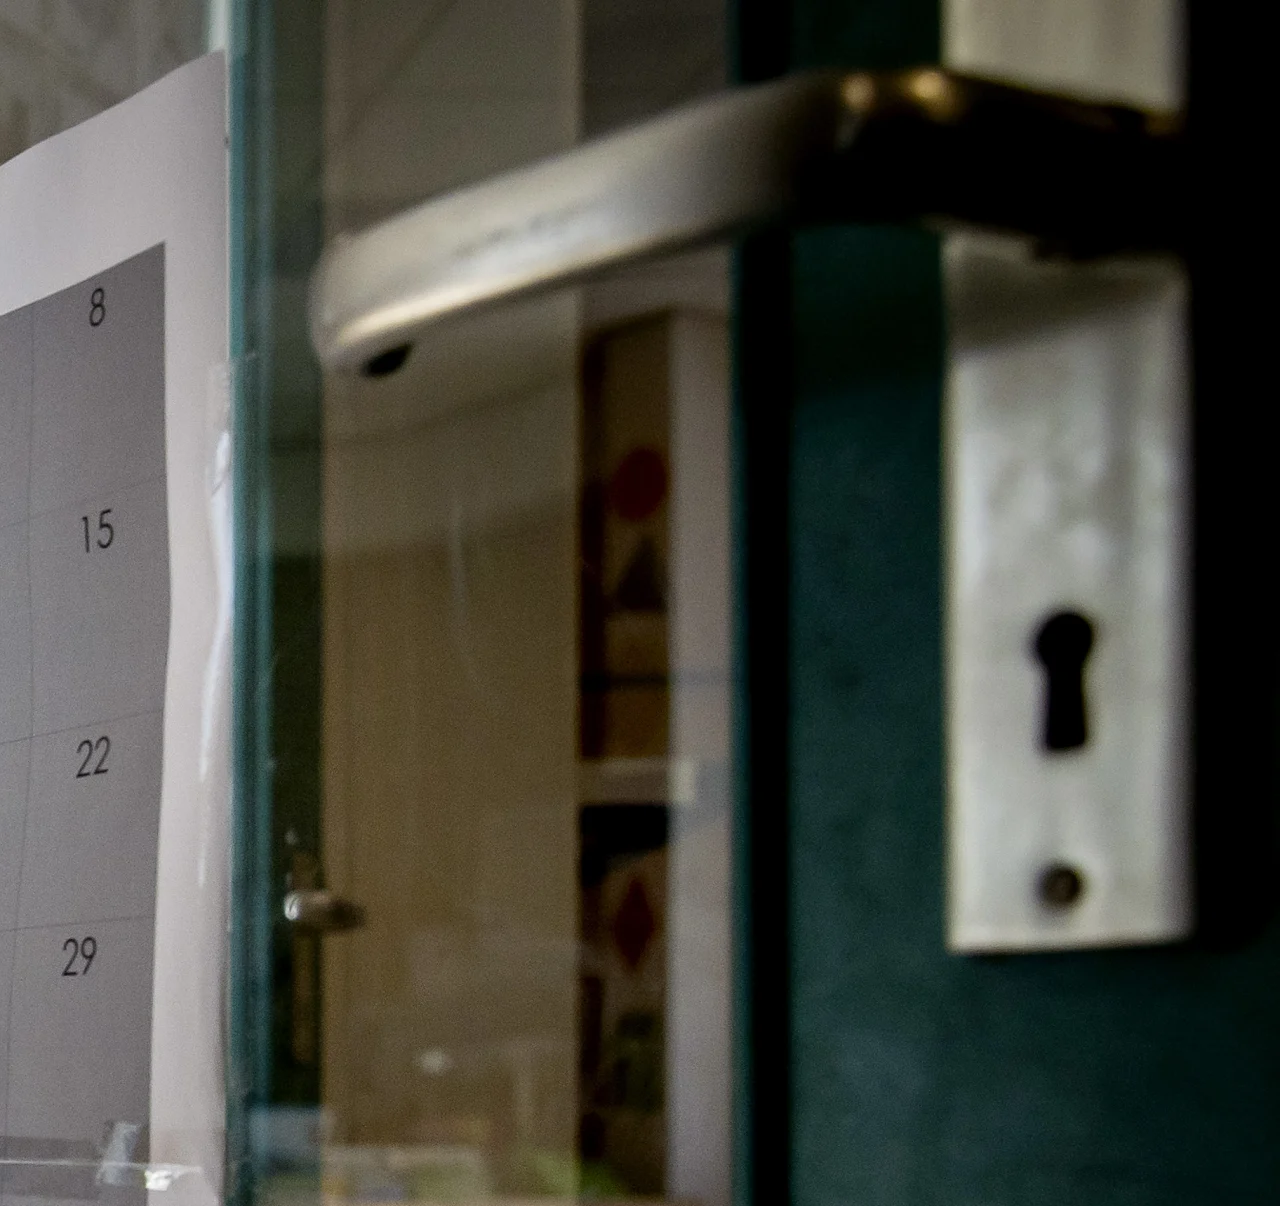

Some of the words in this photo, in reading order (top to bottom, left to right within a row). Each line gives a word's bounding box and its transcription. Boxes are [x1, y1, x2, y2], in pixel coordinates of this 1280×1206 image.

[89, 287, 106, 327] 8
[82, 508, 114, 553] 15
[76, 736, 110, 779] 22
[62, 936, 97, 977] 29
